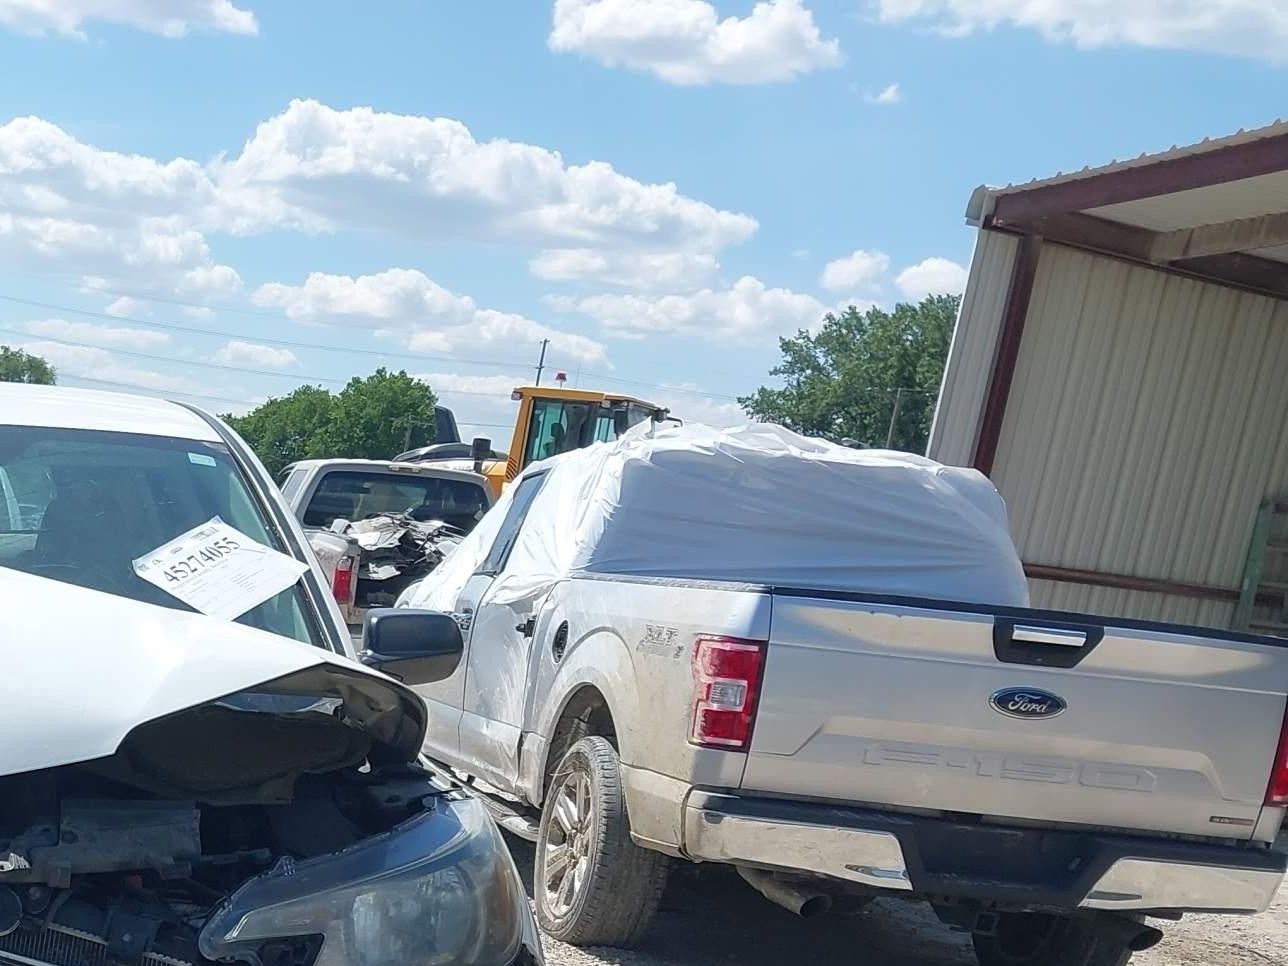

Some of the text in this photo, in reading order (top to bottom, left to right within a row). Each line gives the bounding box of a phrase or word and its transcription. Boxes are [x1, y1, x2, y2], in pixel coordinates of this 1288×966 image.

[163, 537, 241, 582] 45274055
[1008, 693, 1051, 713] Ford
[862, 743, 1158, 794] F-150
